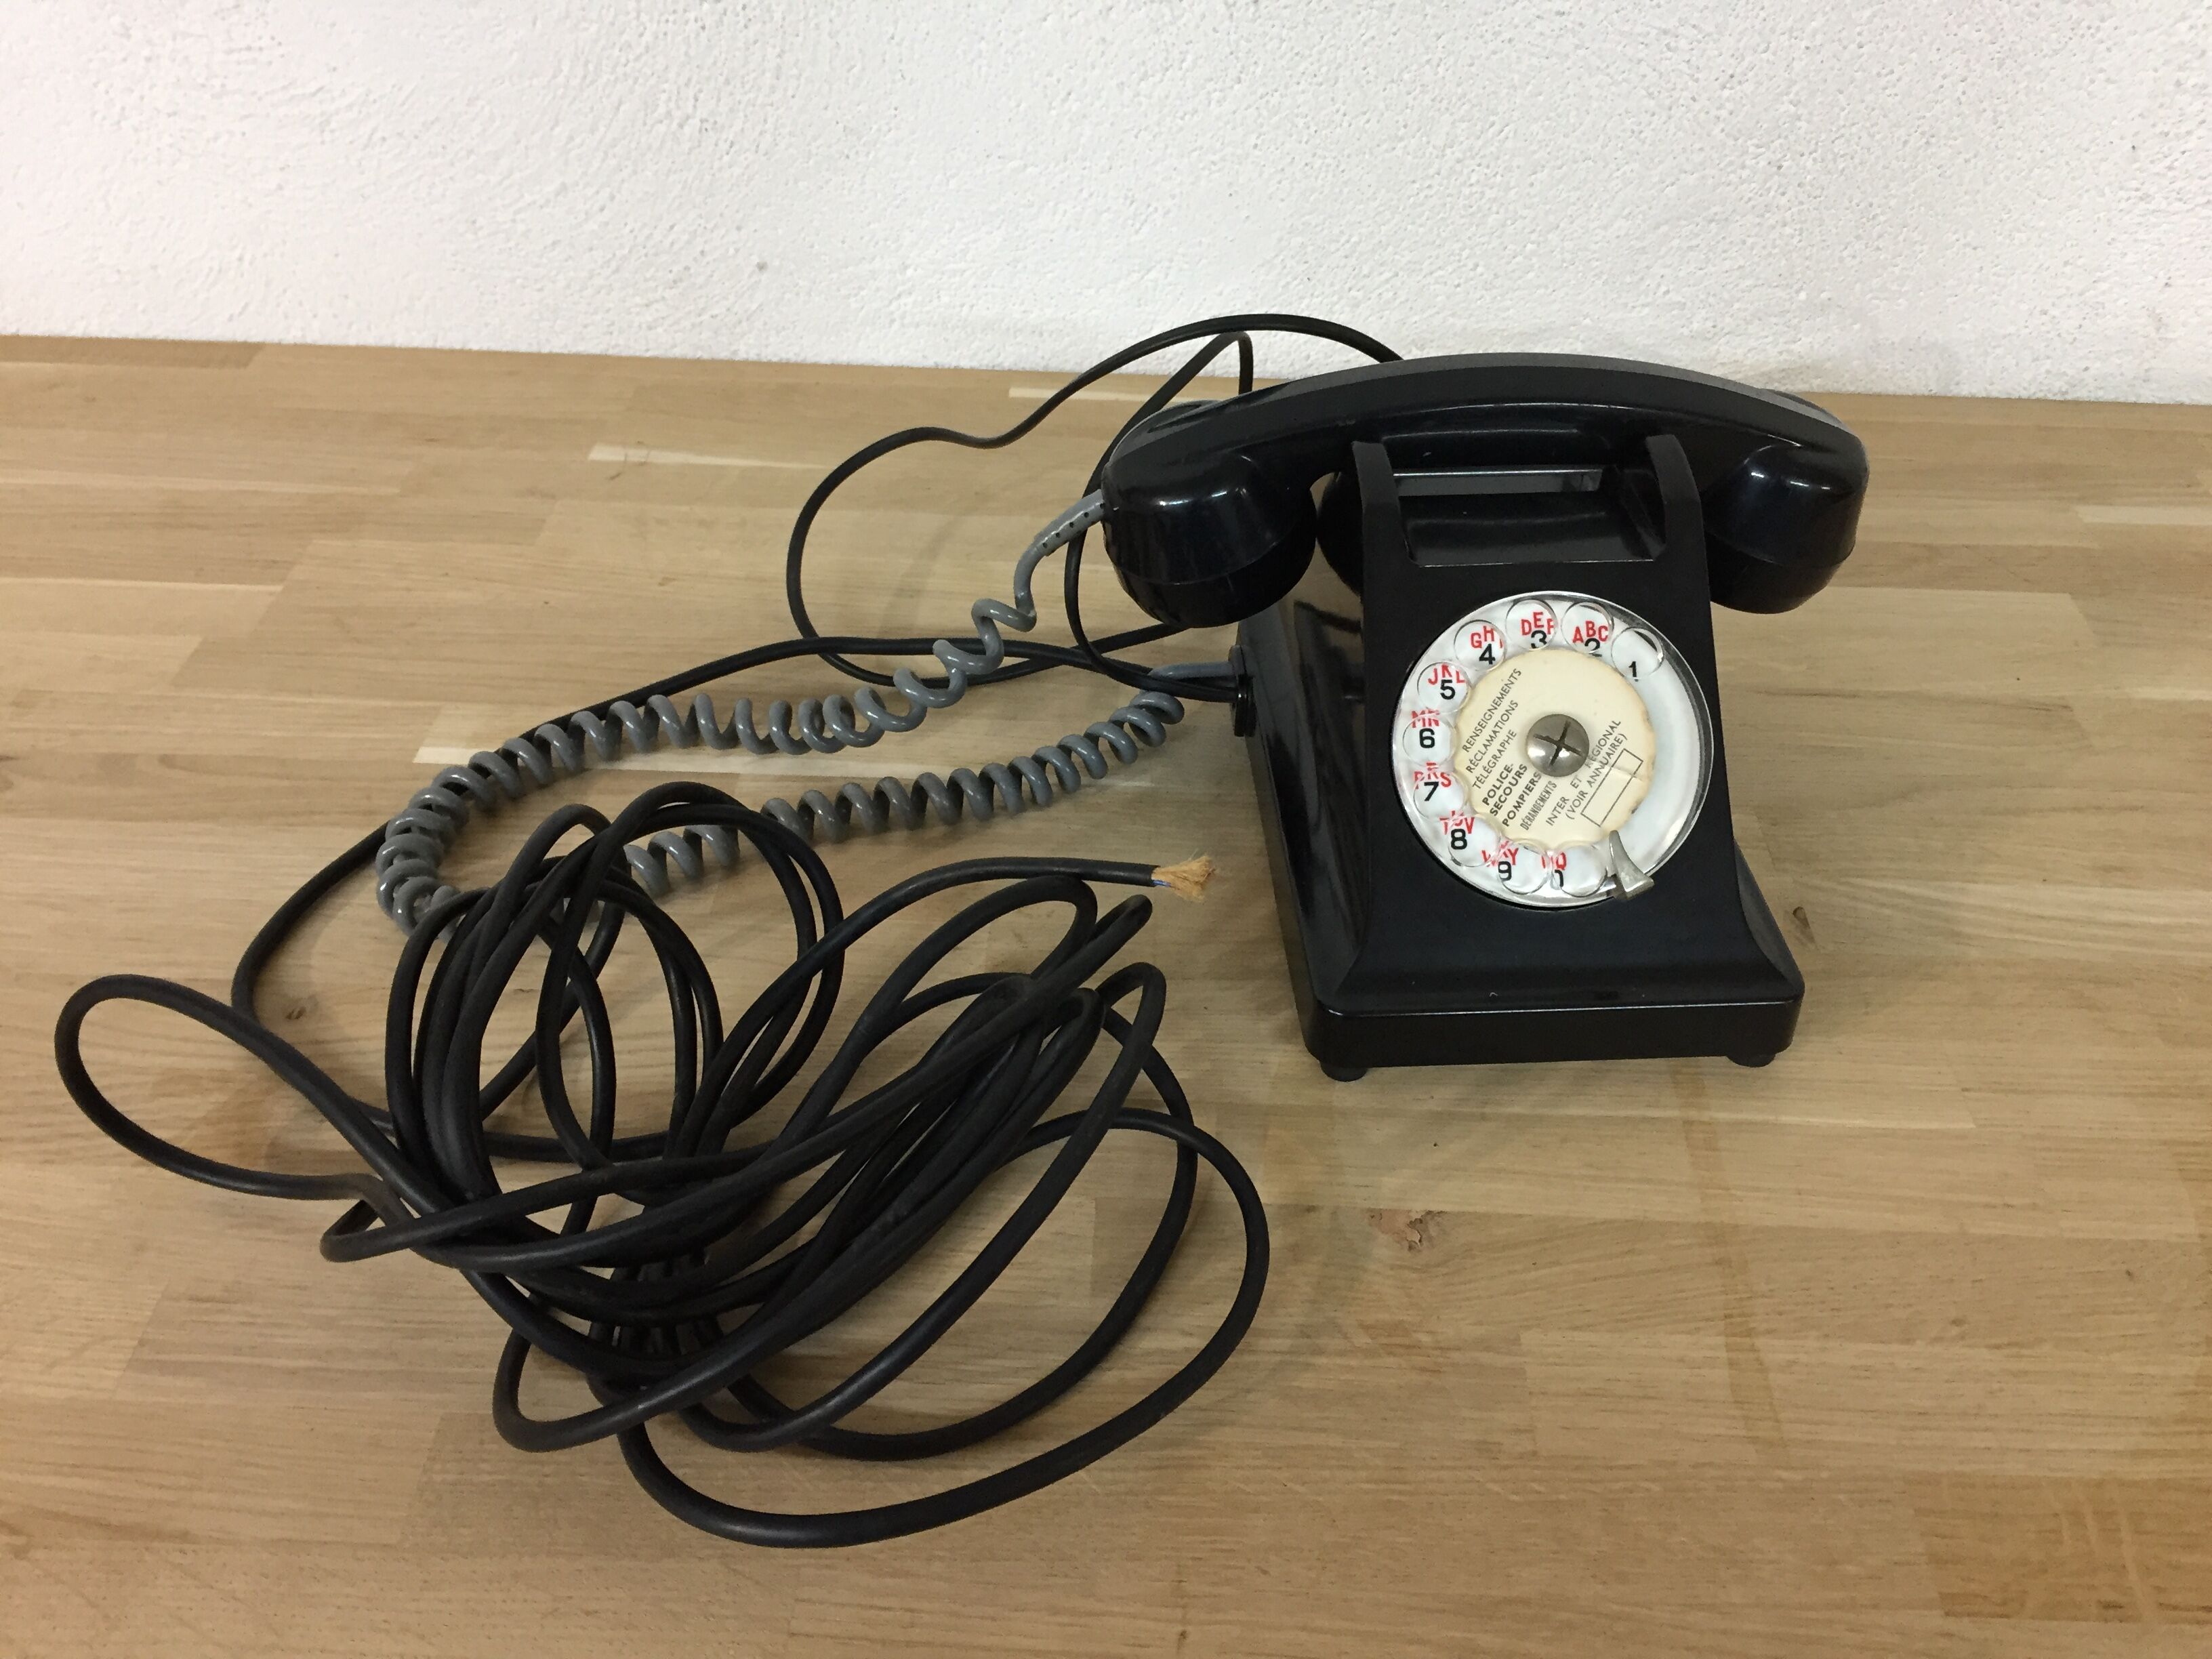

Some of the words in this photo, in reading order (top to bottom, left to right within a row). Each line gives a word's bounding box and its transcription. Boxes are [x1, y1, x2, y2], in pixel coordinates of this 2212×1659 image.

[1531, 630, 1547, 649] 3
[1572, 620, 1608, 643] ABC
[1479, 643, 1496, 665] 4
[1584, 638, 1602, 657] 2
[1629, 661, 1639, 682] 1
[1440, 679, 1456, 700] 5
[1462, 668, 1521, 752] RENSEIGNEMENTS
[1419, 728, 1435, 749] 6
[1466, 700, 1519, 773] RÉCLAMATIONS
[1472, 729, 1517, 789] TÉLÉGRAPHE
[1565, 790, 1589, 820] (VOIR
[1586, 733, 1628, 787] ANNUAIRE)
[1424, 781, 1439, 802] 7
[1490, 764, 1528, 816] SECOURS
[1502, 772, 1542, 827] POMPIERS
[1546, 796, 1570, 826] INTER
[1570, 775, 1582, 789] ET
[1520, 781, 1557, 831] DÉRANGEMENTS
[1450, 828, 1467, 850] 8
[1498, 861, 1512, 881] 9
